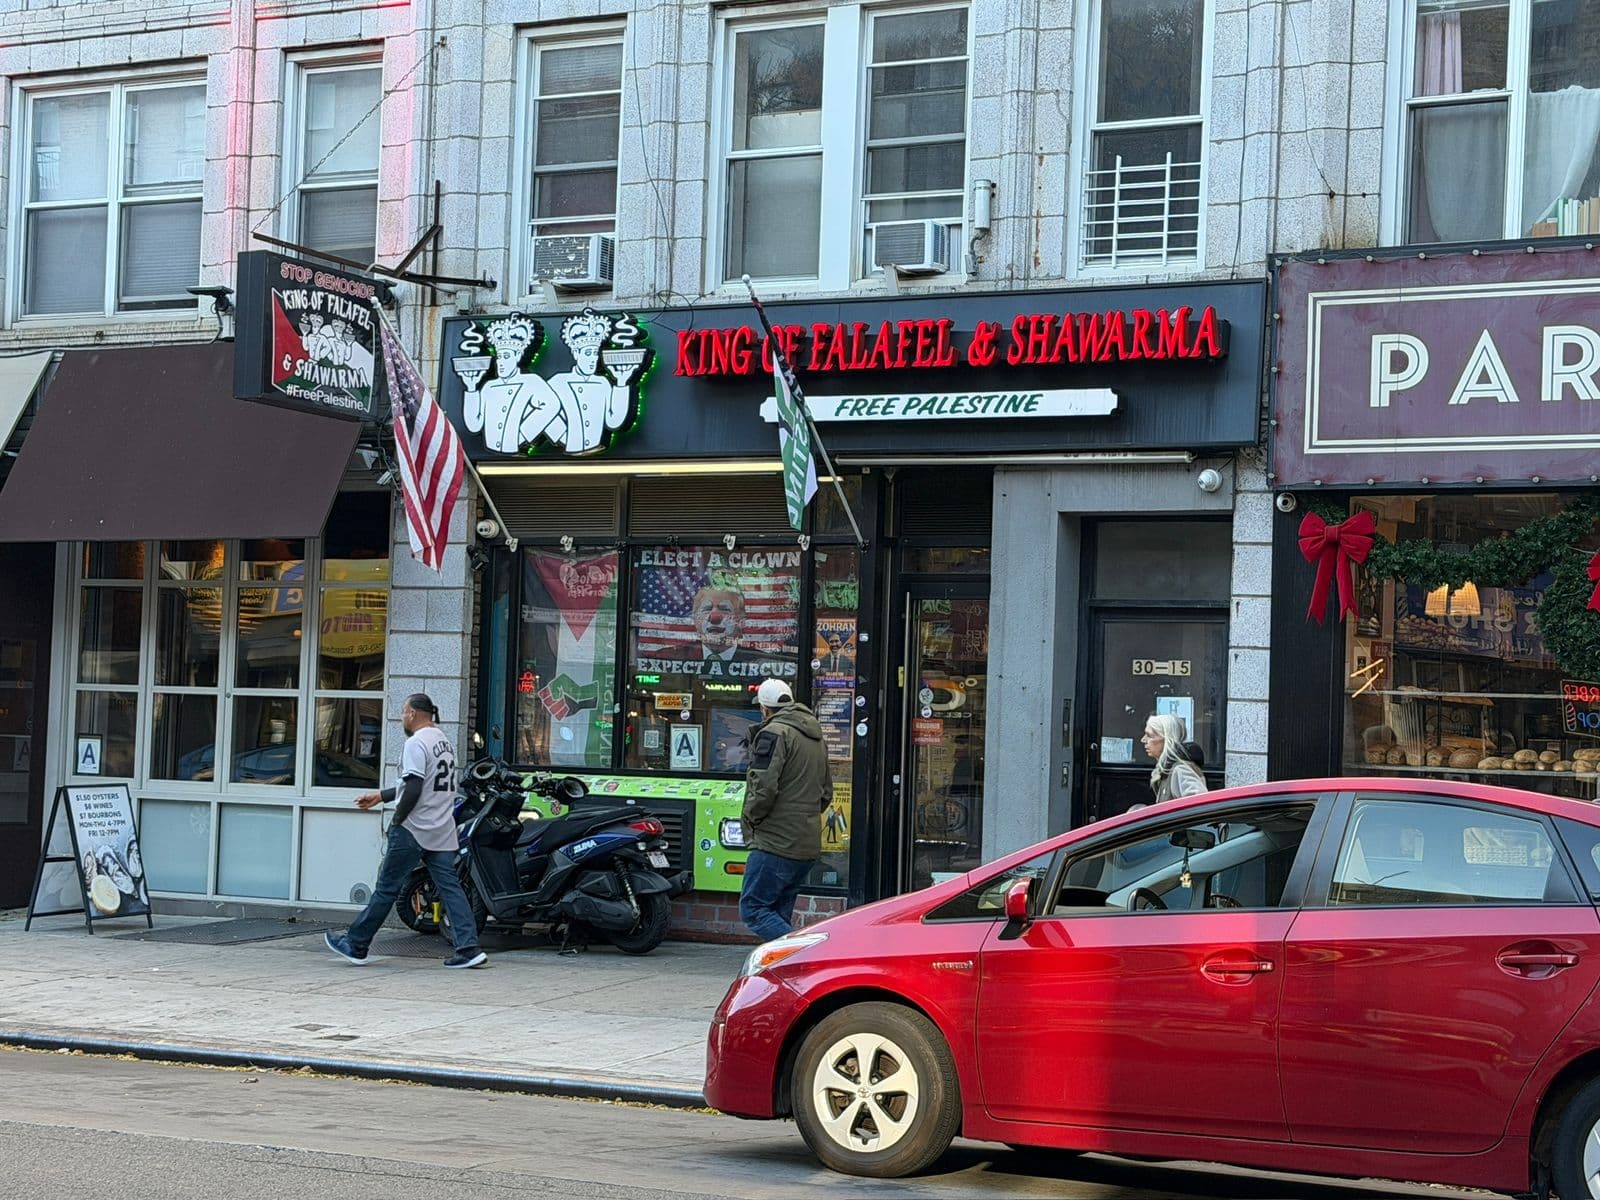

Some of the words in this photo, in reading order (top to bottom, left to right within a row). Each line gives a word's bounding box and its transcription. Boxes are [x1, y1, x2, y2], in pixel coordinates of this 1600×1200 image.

[280, 262, 313, 284] STOP
[314, 271, 375, 299] GENOCIDE
[310, 291, 326, 311] OF
[327, 292, 371, 331] FALAFEL
[673, 325, 757, 377] KING
[762, 324, 805, 374] OF
[807, 318, 956, 371] FALAFEL
[967, 319, 1000, 367] &
[1007, 304, 1222, 366] SHAWARMA
[283, 354, 292, 371] &
[295, 359, 368, 389] SHAWARMA
[1370, 325, 1600, 407] PAR
[286, 384, 365, 411] #FreePalestine
[834, 397, 900, 417] FREE
[901, 393, 1044, 416] PALESTINE
[640, 551, 702, 567] ELECT
[708, 552, 722, 567] A
[728, 552, 800, 568] CLOWN
[816, 622, 856, 631] ZOHRAN
[637, 658, 704, 674] EXPECT
[709, 661, 723, 676] A
[729, 662, 797, 677] CIRCUS
[82, 743, 95, 764] A
[676, 733, 694, 756] A
[88, 810, 122, 819] BOURBONS
